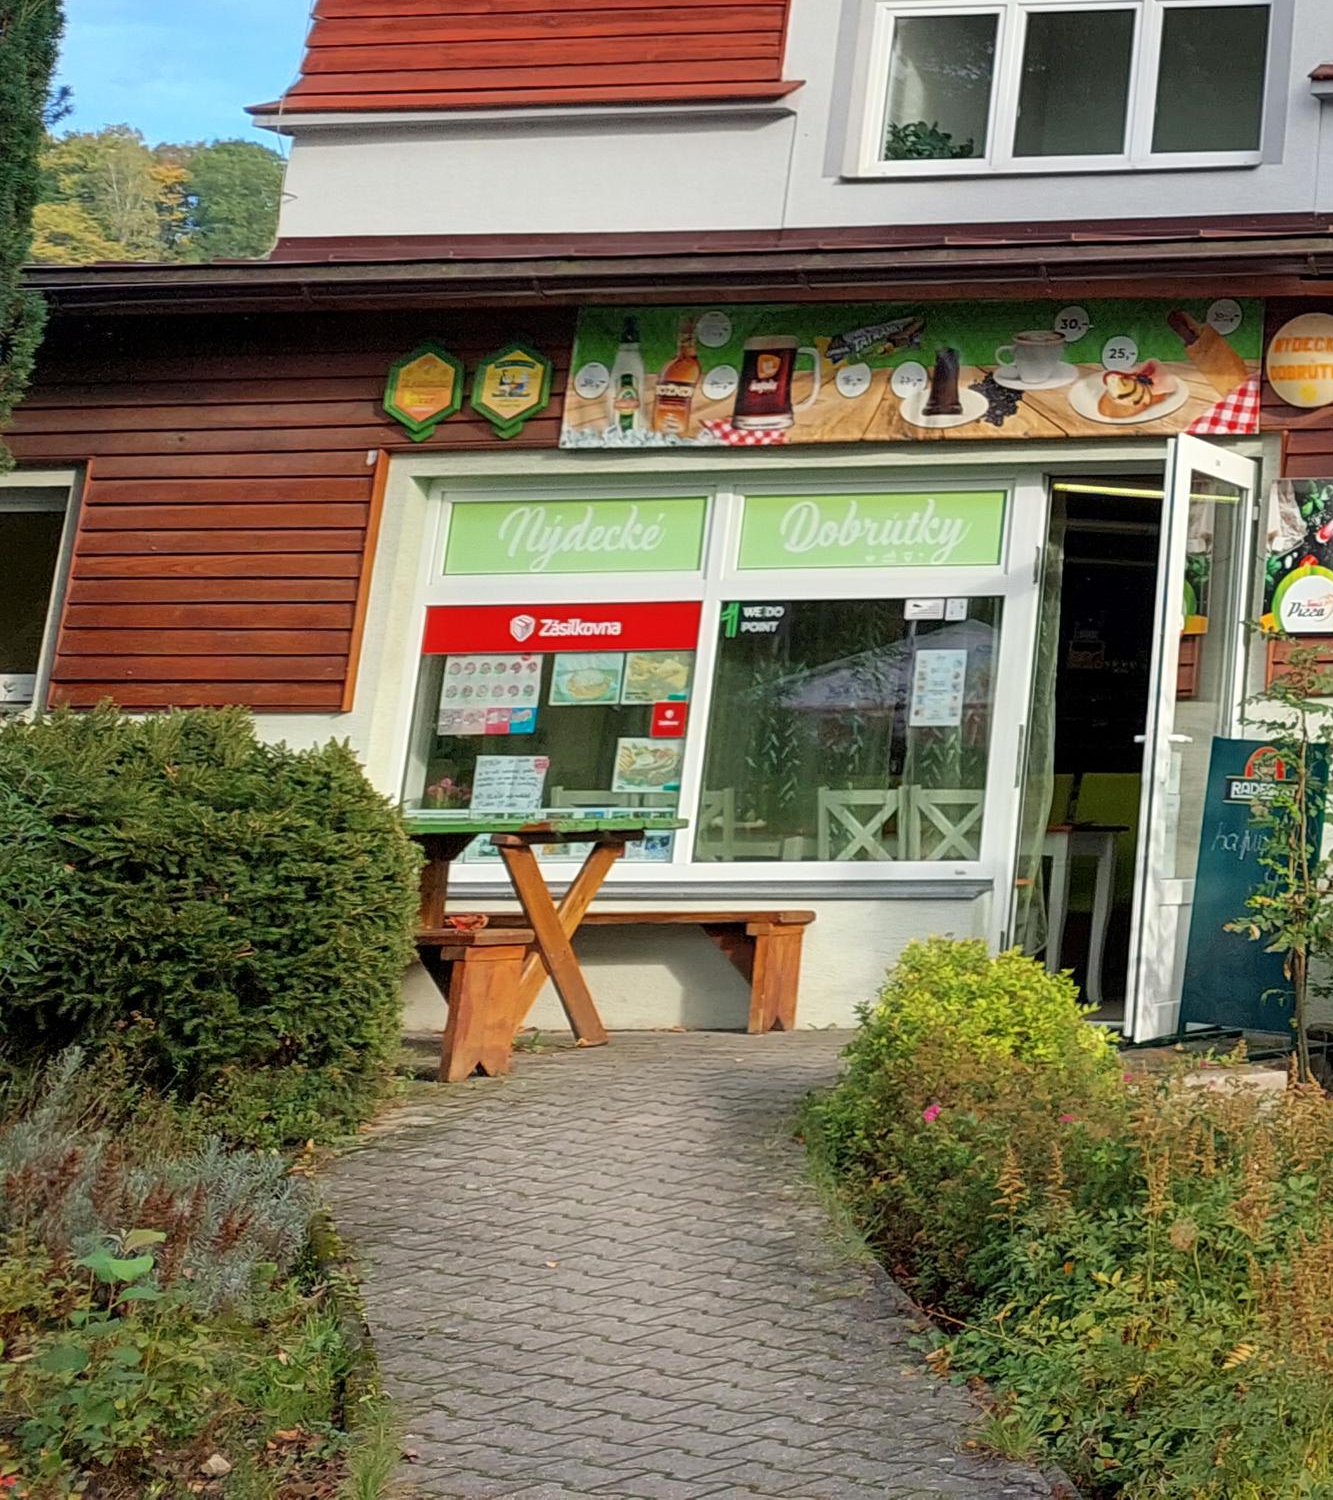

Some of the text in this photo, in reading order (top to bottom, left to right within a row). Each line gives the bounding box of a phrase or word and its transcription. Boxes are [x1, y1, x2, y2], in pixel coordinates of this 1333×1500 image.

[1109, 348, 1136, 361] 25,-
[499, 505, 665, 572] Nýdecké
[780, 499, 972, 564] Dobrútky
[538, 618, 622, 637] Zásilkovna
[740, 621, 779, 633] POINT
